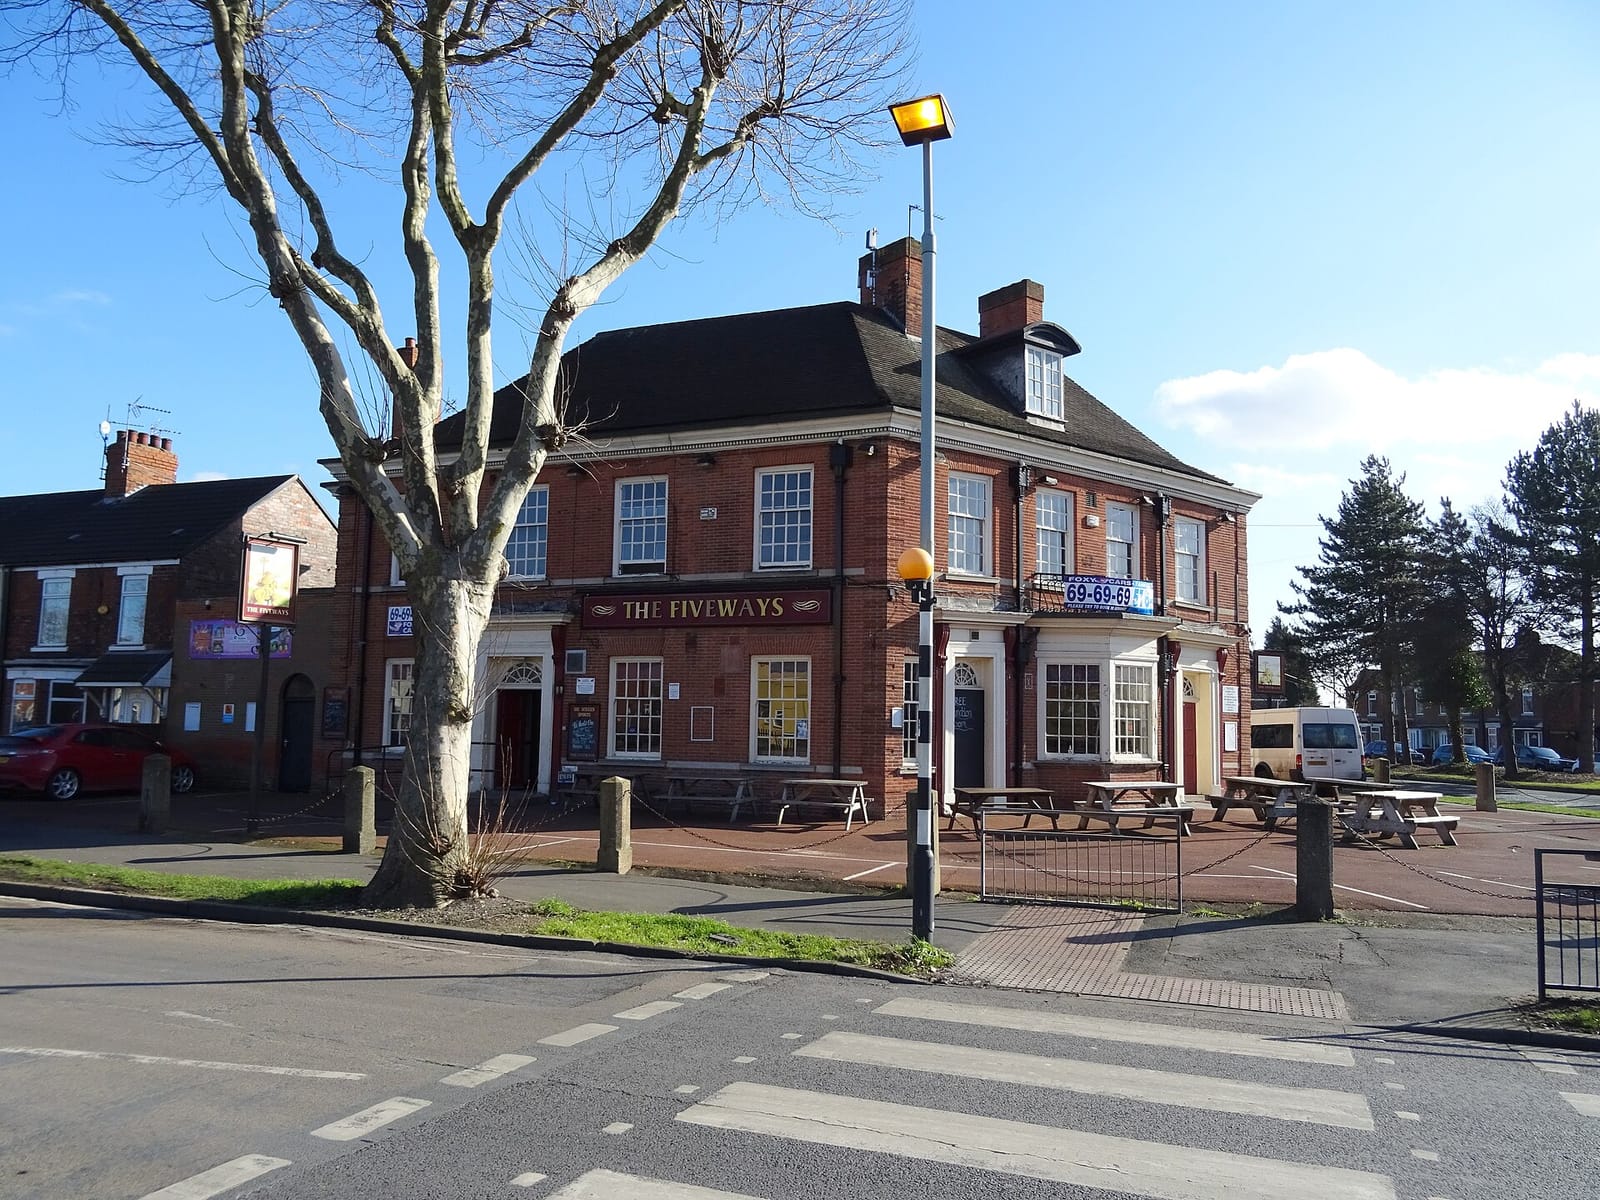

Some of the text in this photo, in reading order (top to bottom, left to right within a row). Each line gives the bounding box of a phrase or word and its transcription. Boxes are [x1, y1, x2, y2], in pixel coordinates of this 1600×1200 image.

[1066, 584, 1131, 606] 69-69-69
[259, 607, 289, 616] FIVEWAYS
[623, 597, 784, 619] THE FIVEWAYS
